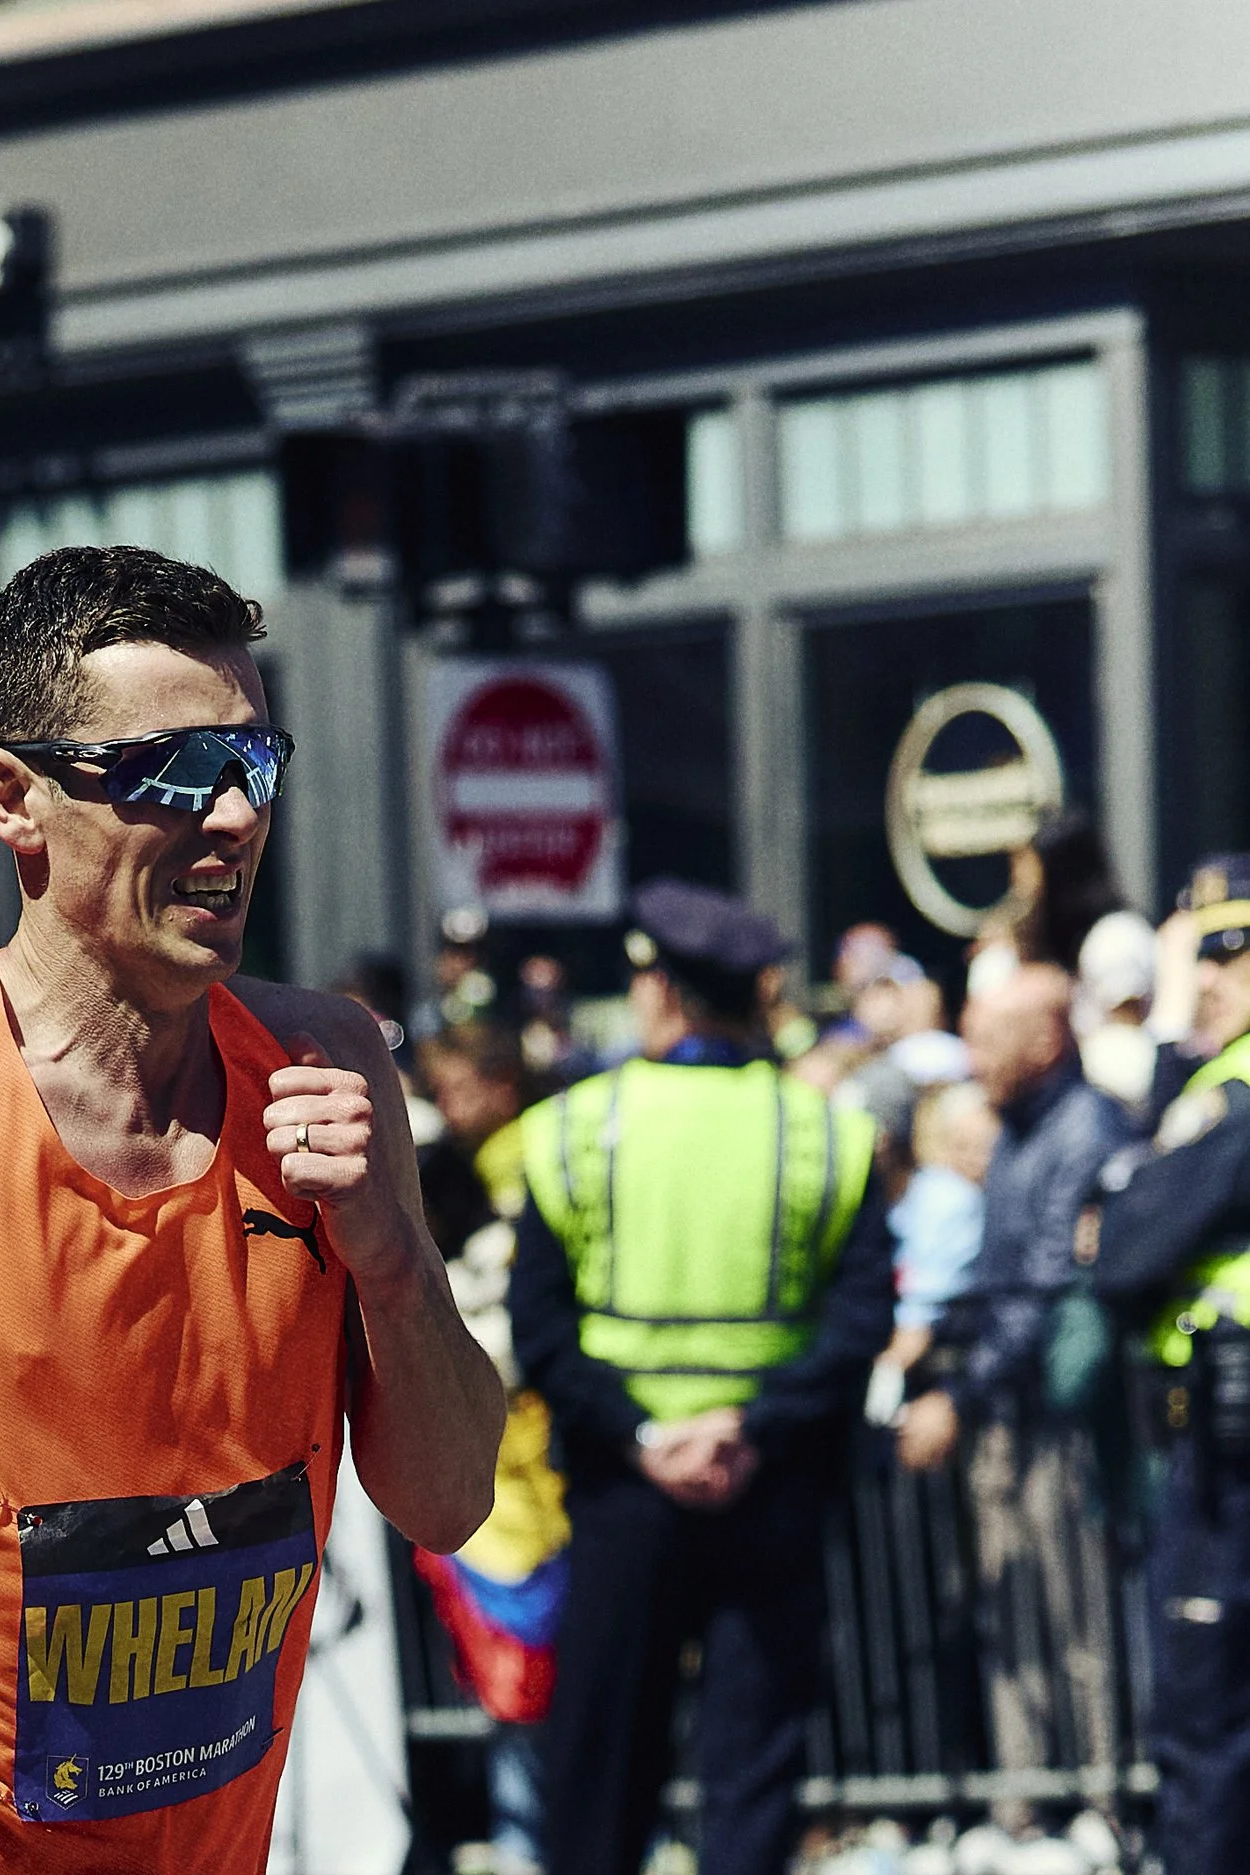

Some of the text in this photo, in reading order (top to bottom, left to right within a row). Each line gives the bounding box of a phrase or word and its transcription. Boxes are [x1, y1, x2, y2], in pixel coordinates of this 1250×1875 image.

[24, 1562, 313, 1705] WHELAN
[135, 1747, 195, 1776] BOSTON
[200, 1715, 256, 1761] MARATHON
[98, 1767, 207, 1798] BANK OF AMERICA
